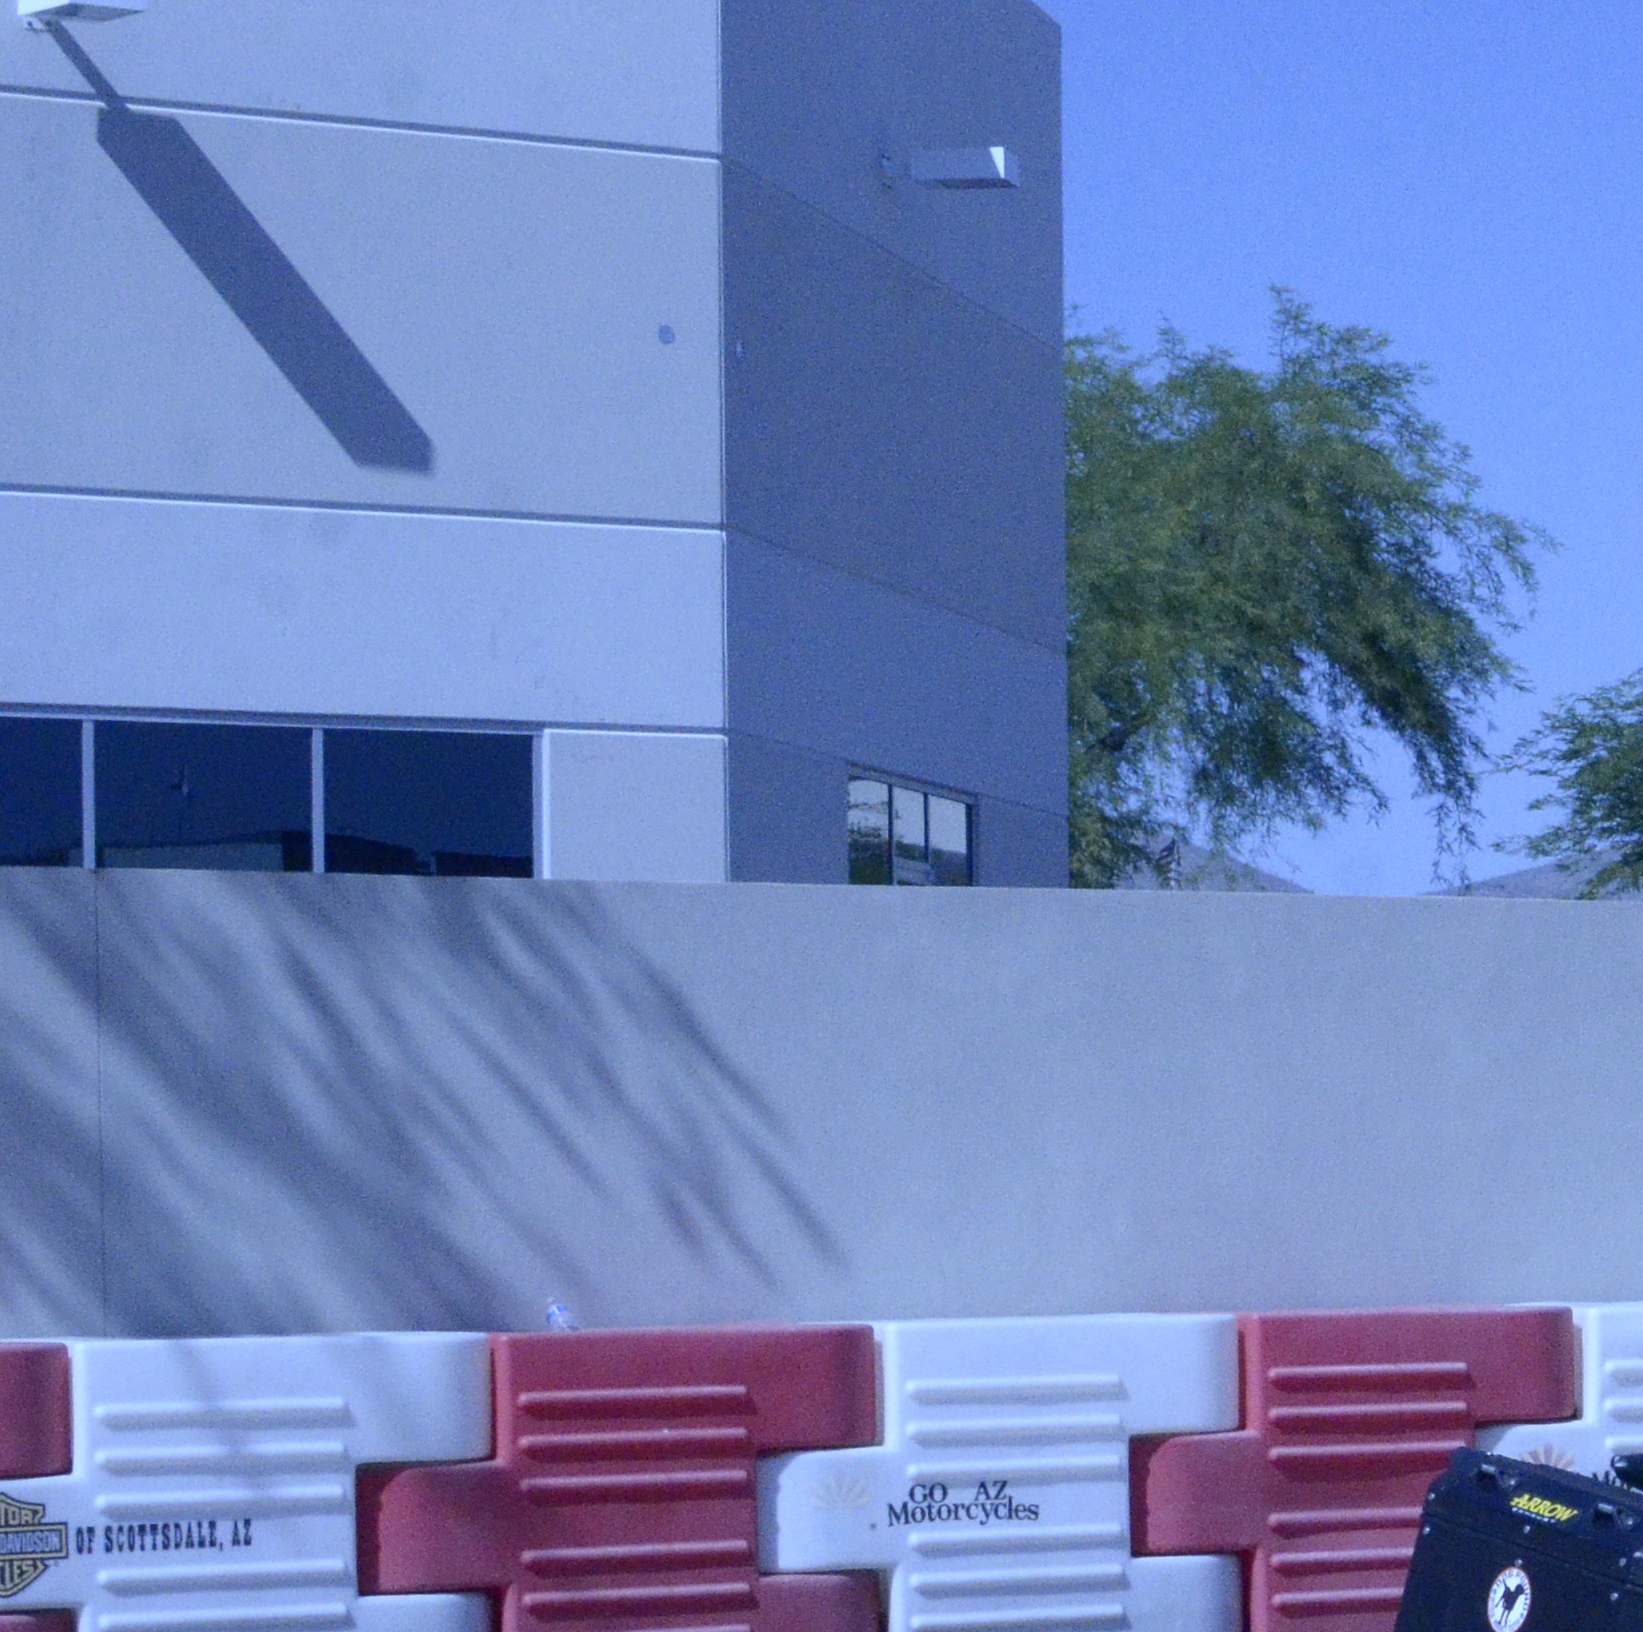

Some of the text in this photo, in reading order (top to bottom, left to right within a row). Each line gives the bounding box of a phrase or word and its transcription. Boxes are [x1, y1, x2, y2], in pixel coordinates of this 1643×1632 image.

[908, 1480, 1008, 1504] GO AZ
[887, 1495, 1039, 1527] Motorcycles
[1510, 1494, 1578, 1521] ARROW
[76, 1526, 95, 1554] OF
[232, 1518, 252, 1547] AZ
